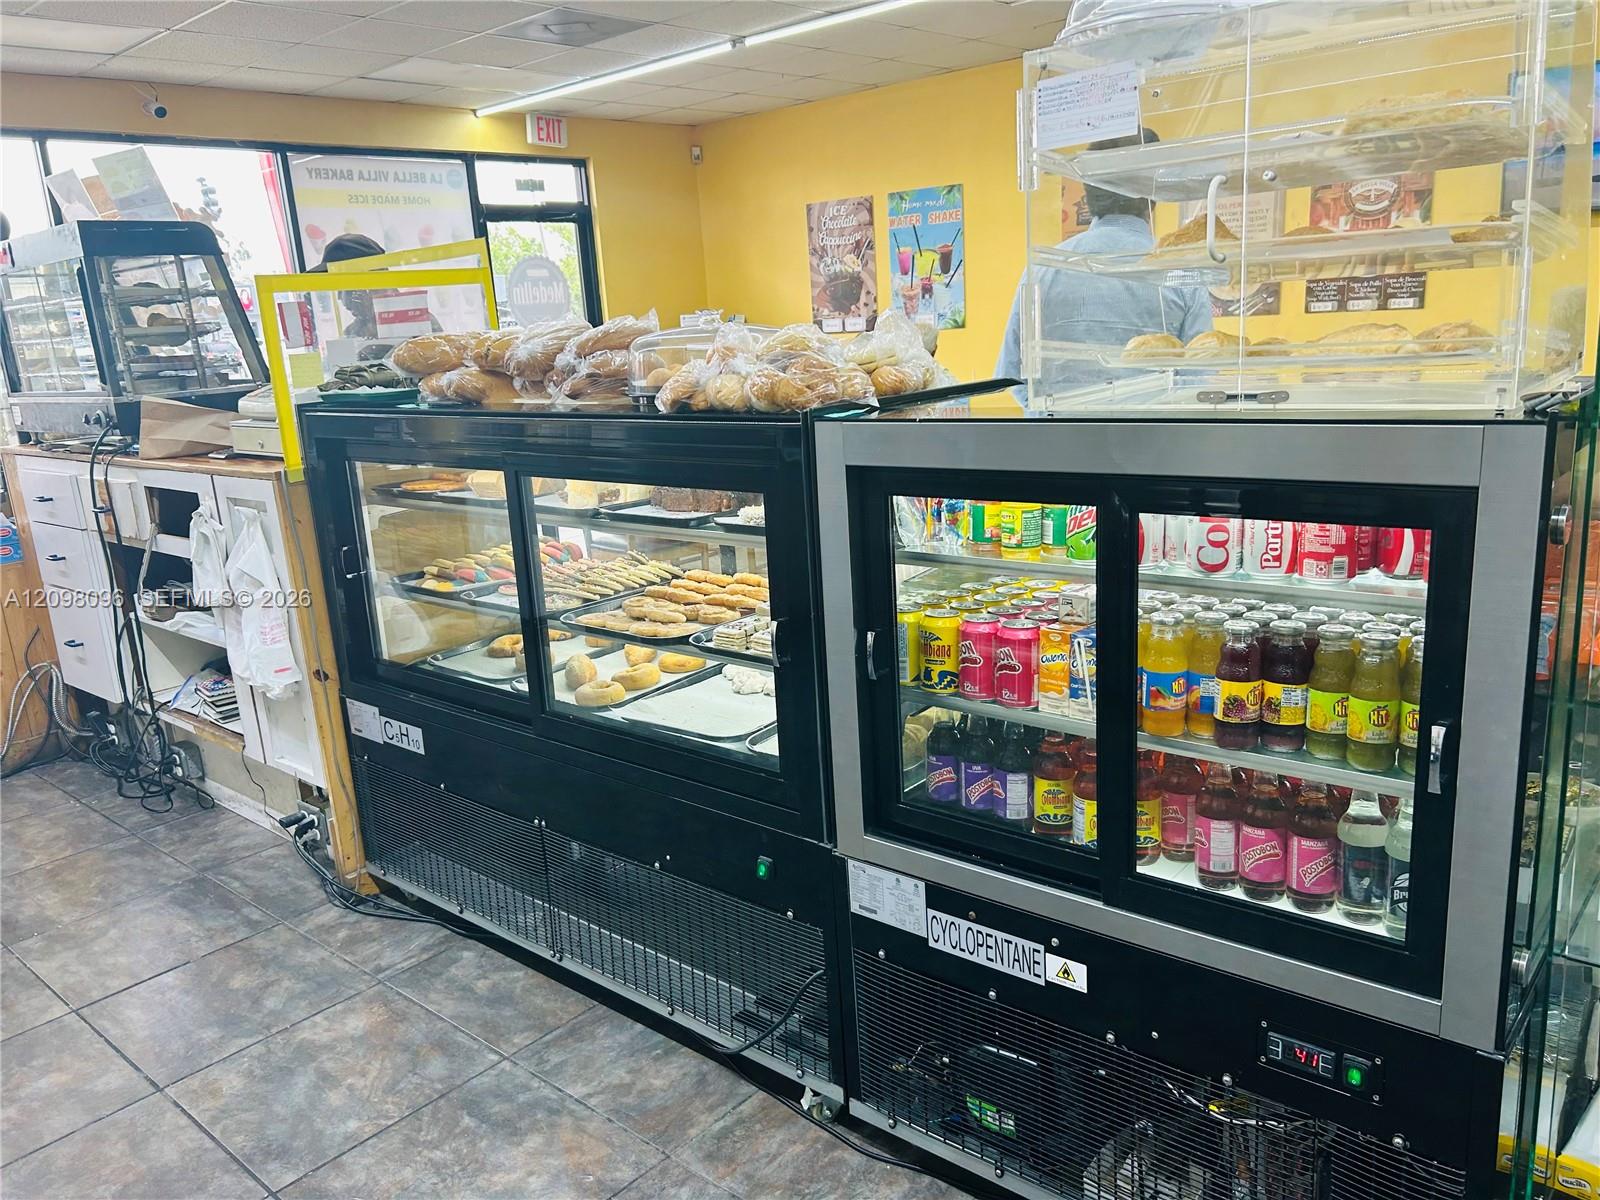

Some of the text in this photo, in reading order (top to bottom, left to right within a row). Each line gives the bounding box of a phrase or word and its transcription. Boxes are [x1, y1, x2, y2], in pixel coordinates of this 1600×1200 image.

[536, 114, 562, 144] EXIT
[829, 205, 847, 217] ICE
[889, 209, 961, 229] WATER SHAKE
[821, 215, 858, 231] Chocolate
[967, 776, 992, 797] POSTOBO
[1243, 841, 1279, 865] POSTOBON
[930, 914, 1043, 980] CYCLOPENTANE
[1295, 1047, 1319, 1068] 41
